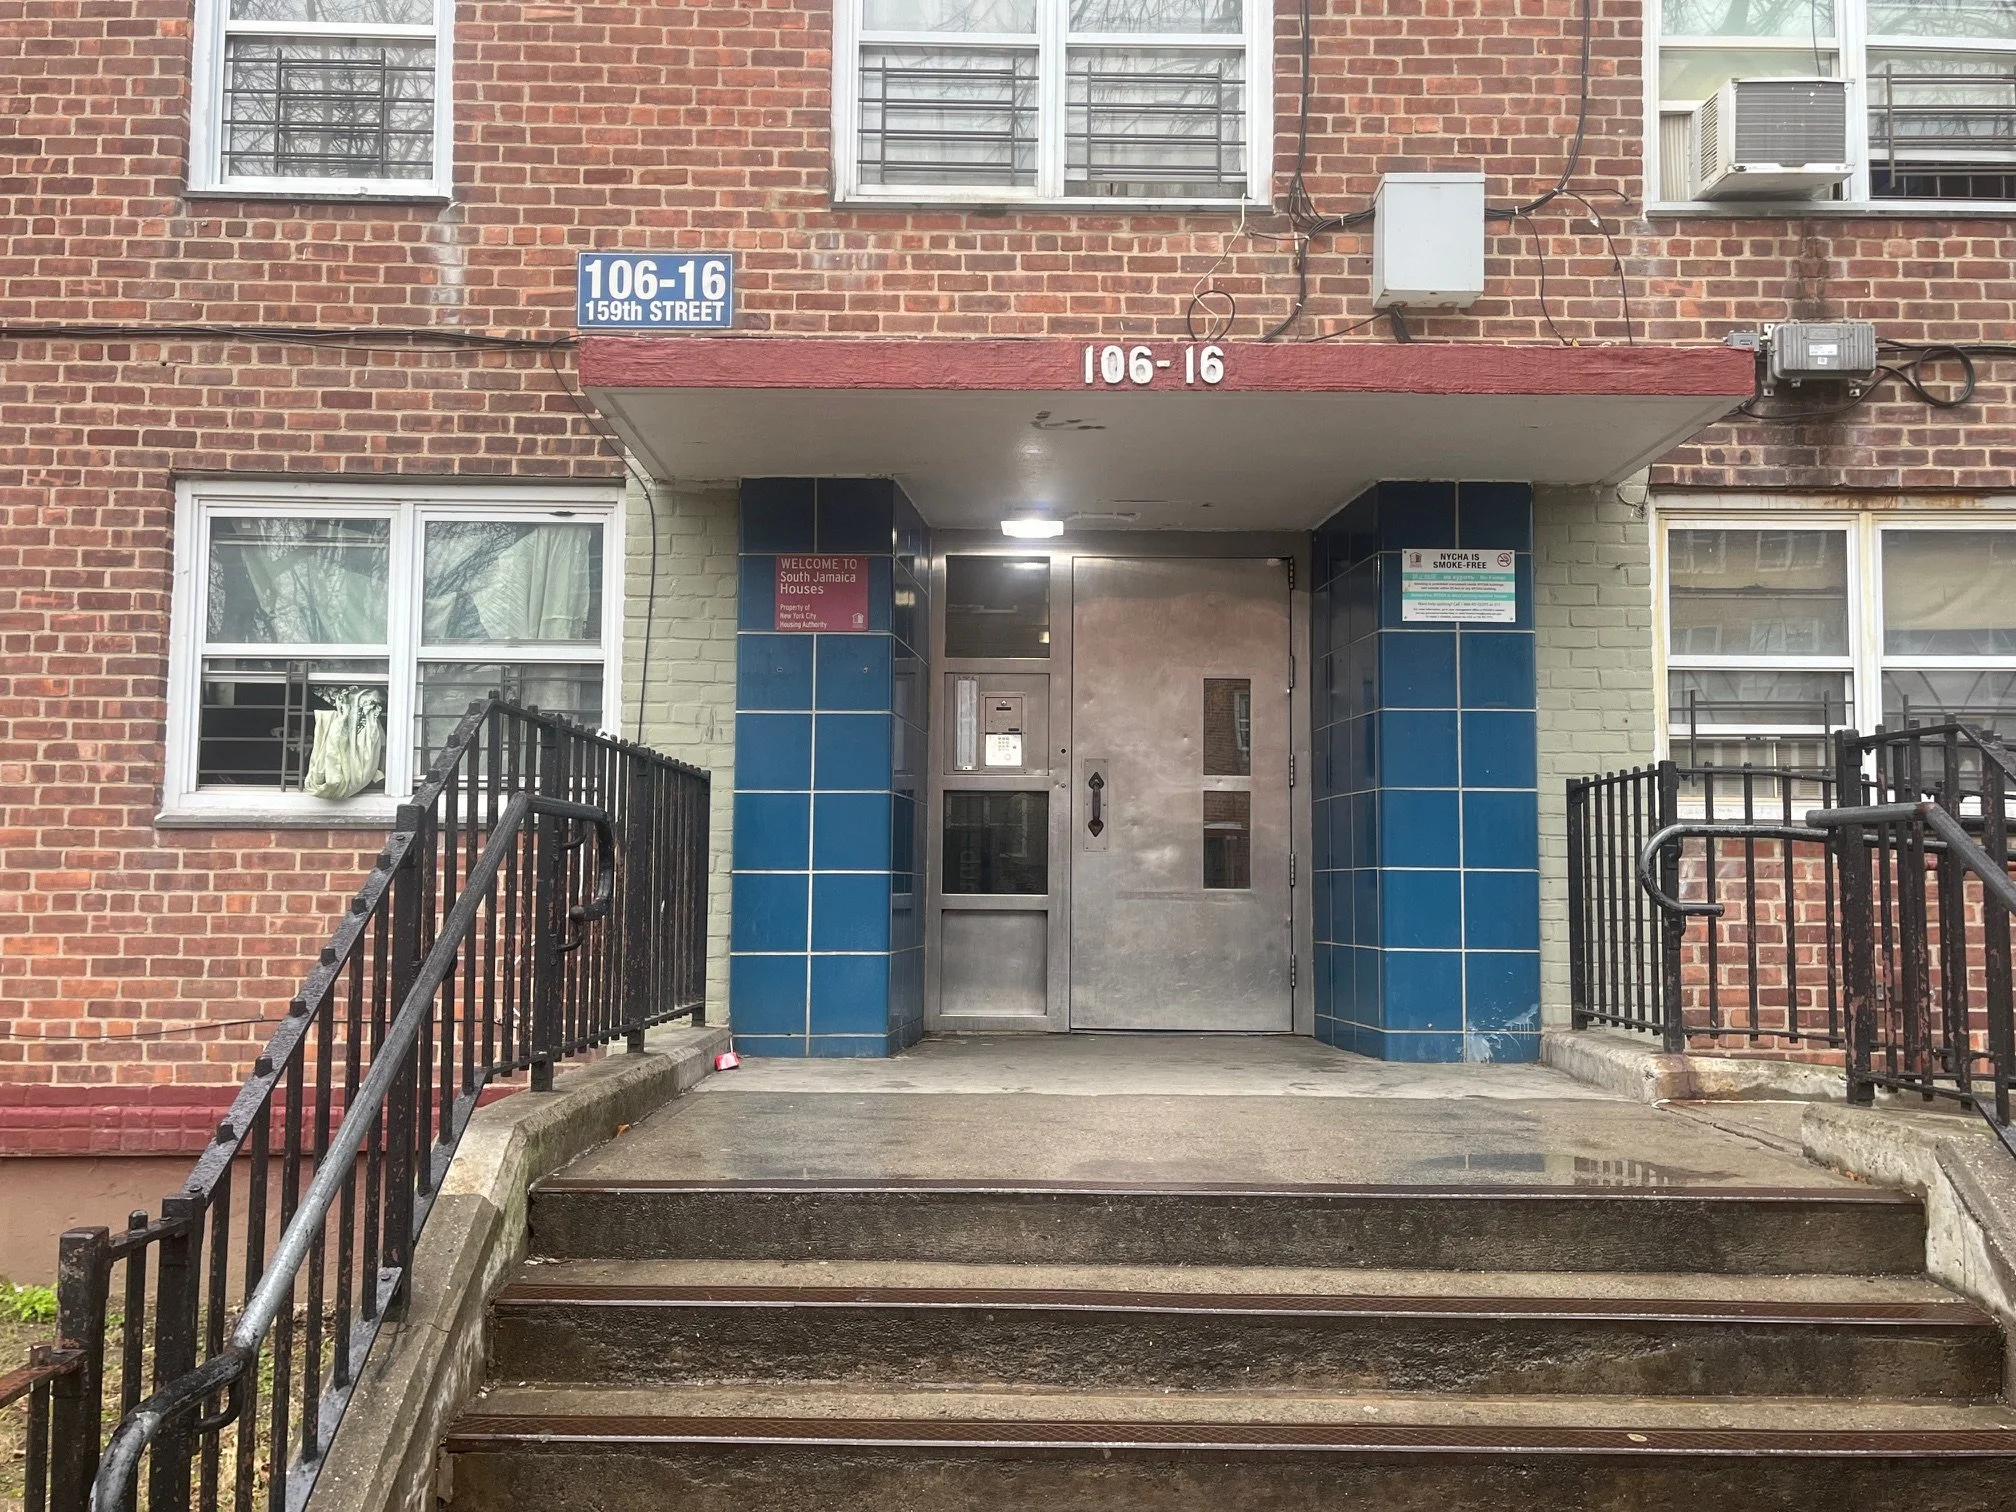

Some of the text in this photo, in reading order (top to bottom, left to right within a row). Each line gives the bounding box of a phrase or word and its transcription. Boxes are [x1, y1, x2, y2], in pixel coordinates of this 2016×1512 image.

[585, 259, 726, 300] 106-16
[585, 300, 725, 322] 159th STREET
[780, 558, 858, 570] WELCOME TO
[1433, 561, 1487, 569] SMOKE-FREE
[780, 571, 856, 583] South Jamaica
[780, 583, 824, 594] Houses
[780, 603, 803, 611] Property
[805, 612, 817, 620] City
[780, 621, 801, 629] Housing
